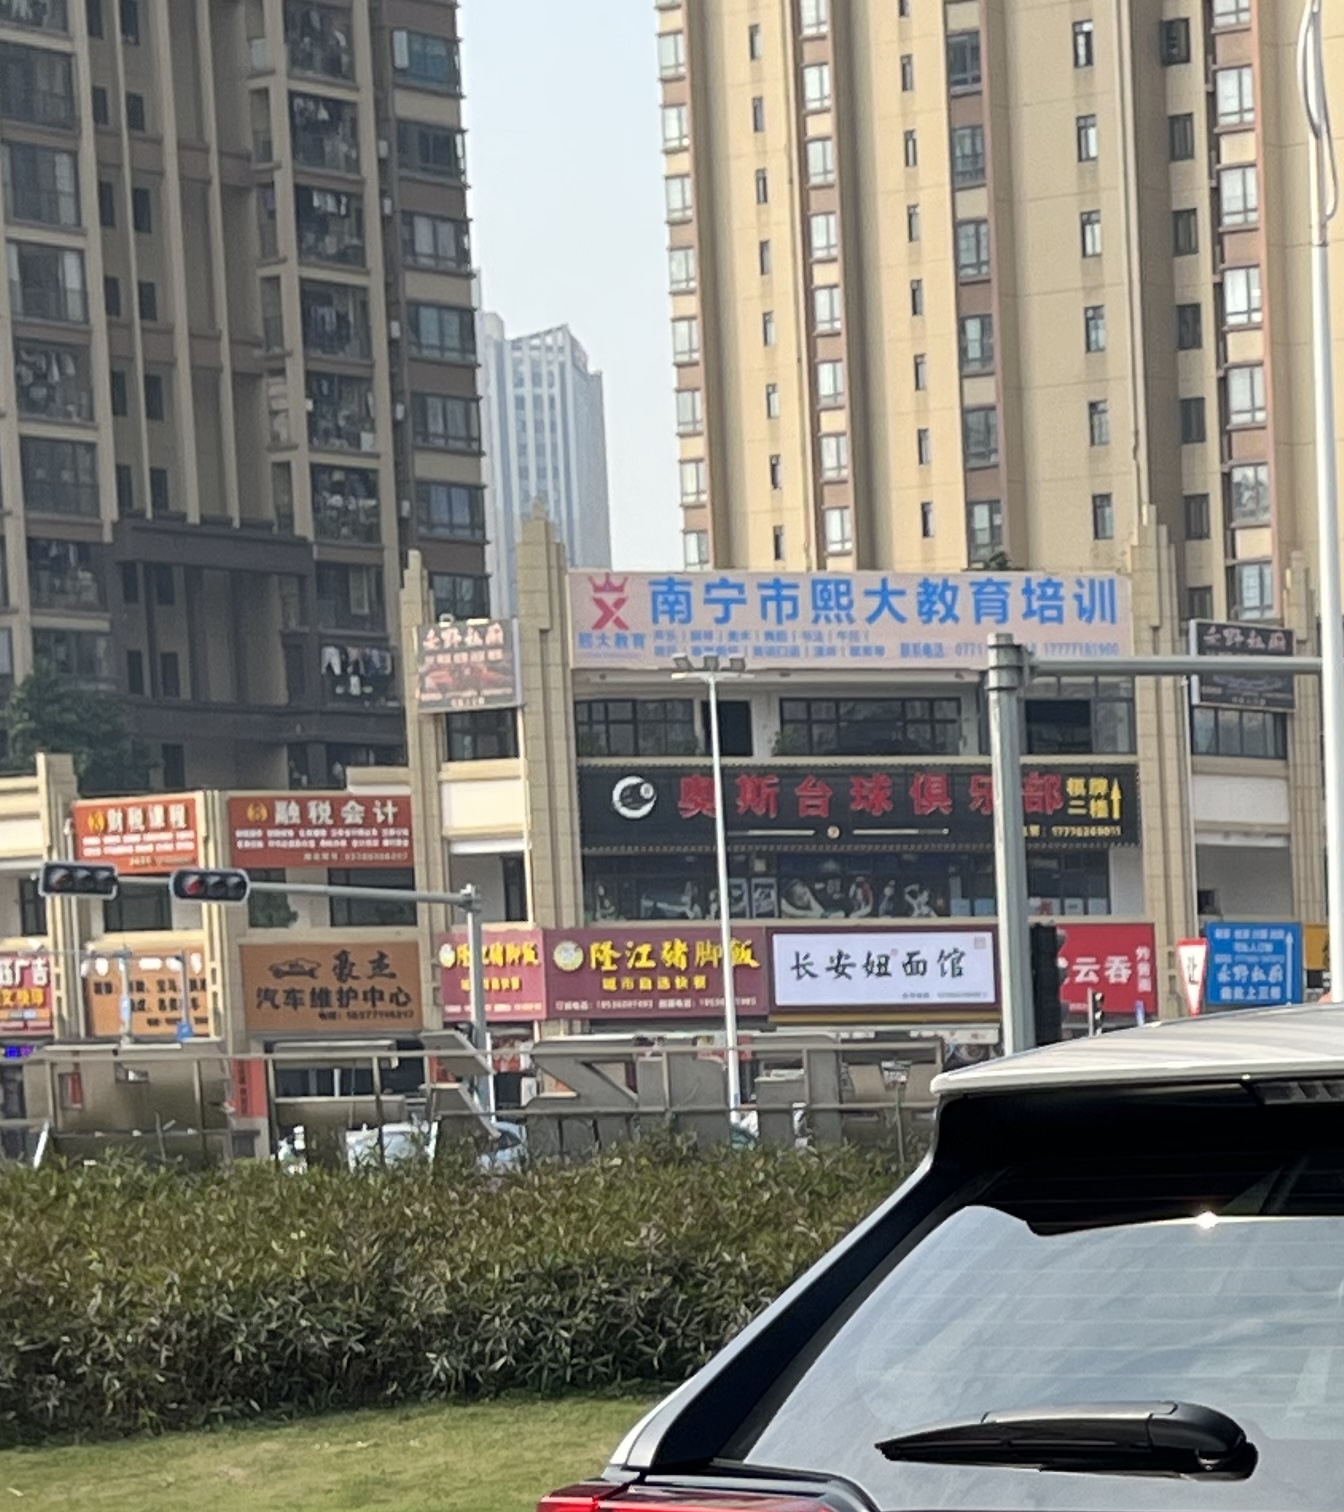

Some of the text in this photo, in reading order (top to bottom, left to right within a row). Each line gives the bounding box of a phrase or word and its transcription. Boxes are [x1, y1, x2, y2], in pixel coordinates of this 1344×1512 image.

[648, 576, 1118, 625] 南宁市熙大教育培训
[1061, 955, 1133, 985] 云吞
[256, 986, 413, 1011] 汽车维护中心
